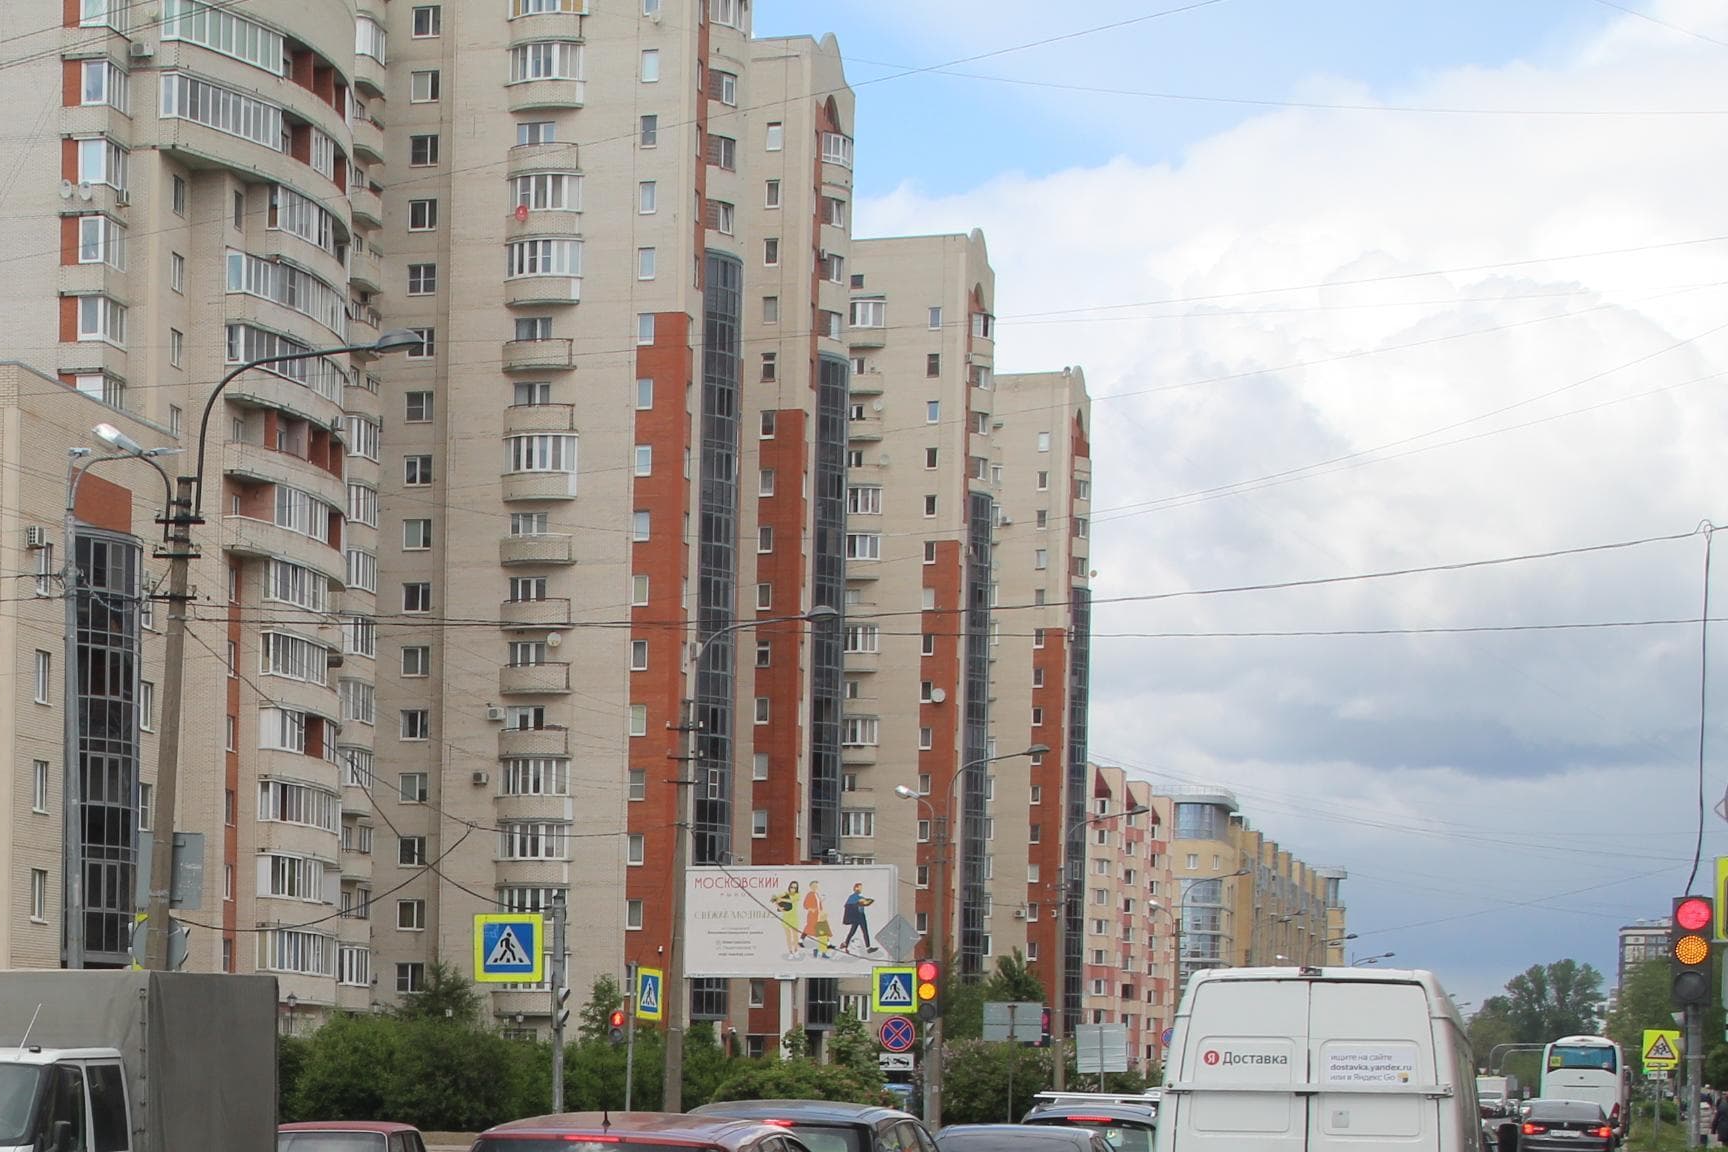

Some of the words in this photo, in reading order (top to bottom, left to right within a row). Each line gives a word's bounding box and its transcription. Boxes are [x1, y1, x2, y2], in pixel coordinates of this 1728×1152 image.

[694, 874, 779, 889] МОСКОВСКИЙ
[1222, 1051, 1288, 1066] Доставка
[1330, 1054, 1357, 1062] ищите
[1369, 1053, 1392, 1061] сайте
[1330, 1064, 1412, 1072] dostavka.yandex.ru
[1353, 1073, 1382, 1081] Яндекс
[1384, 1073, 1395, 1081] Go
